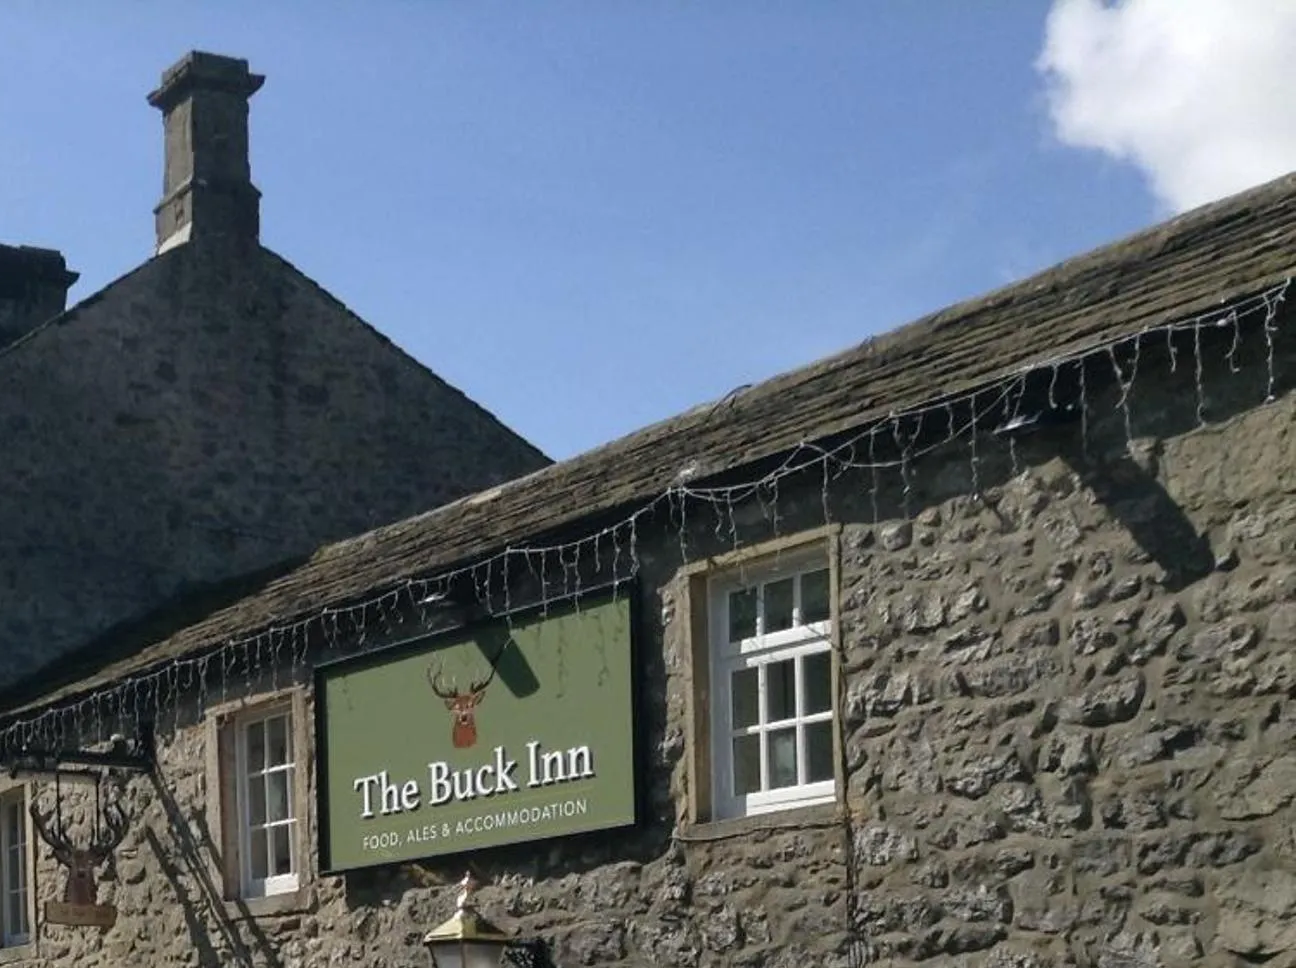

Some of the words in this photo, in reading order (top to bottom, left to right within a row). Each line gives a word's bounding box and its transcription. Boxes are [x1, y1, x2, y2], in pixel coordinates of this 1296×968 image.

[354, 770, 420, 818] The
[428, 746, 517, 805] Buck
[526, 740, 594, 787] Inn
[363, 830, 403, 851] FOOD,
[407, 824, 437, 843] ALES
[441, 823, 452, 838] &
[456, 799, 588, 834] ACCOMMODATION
